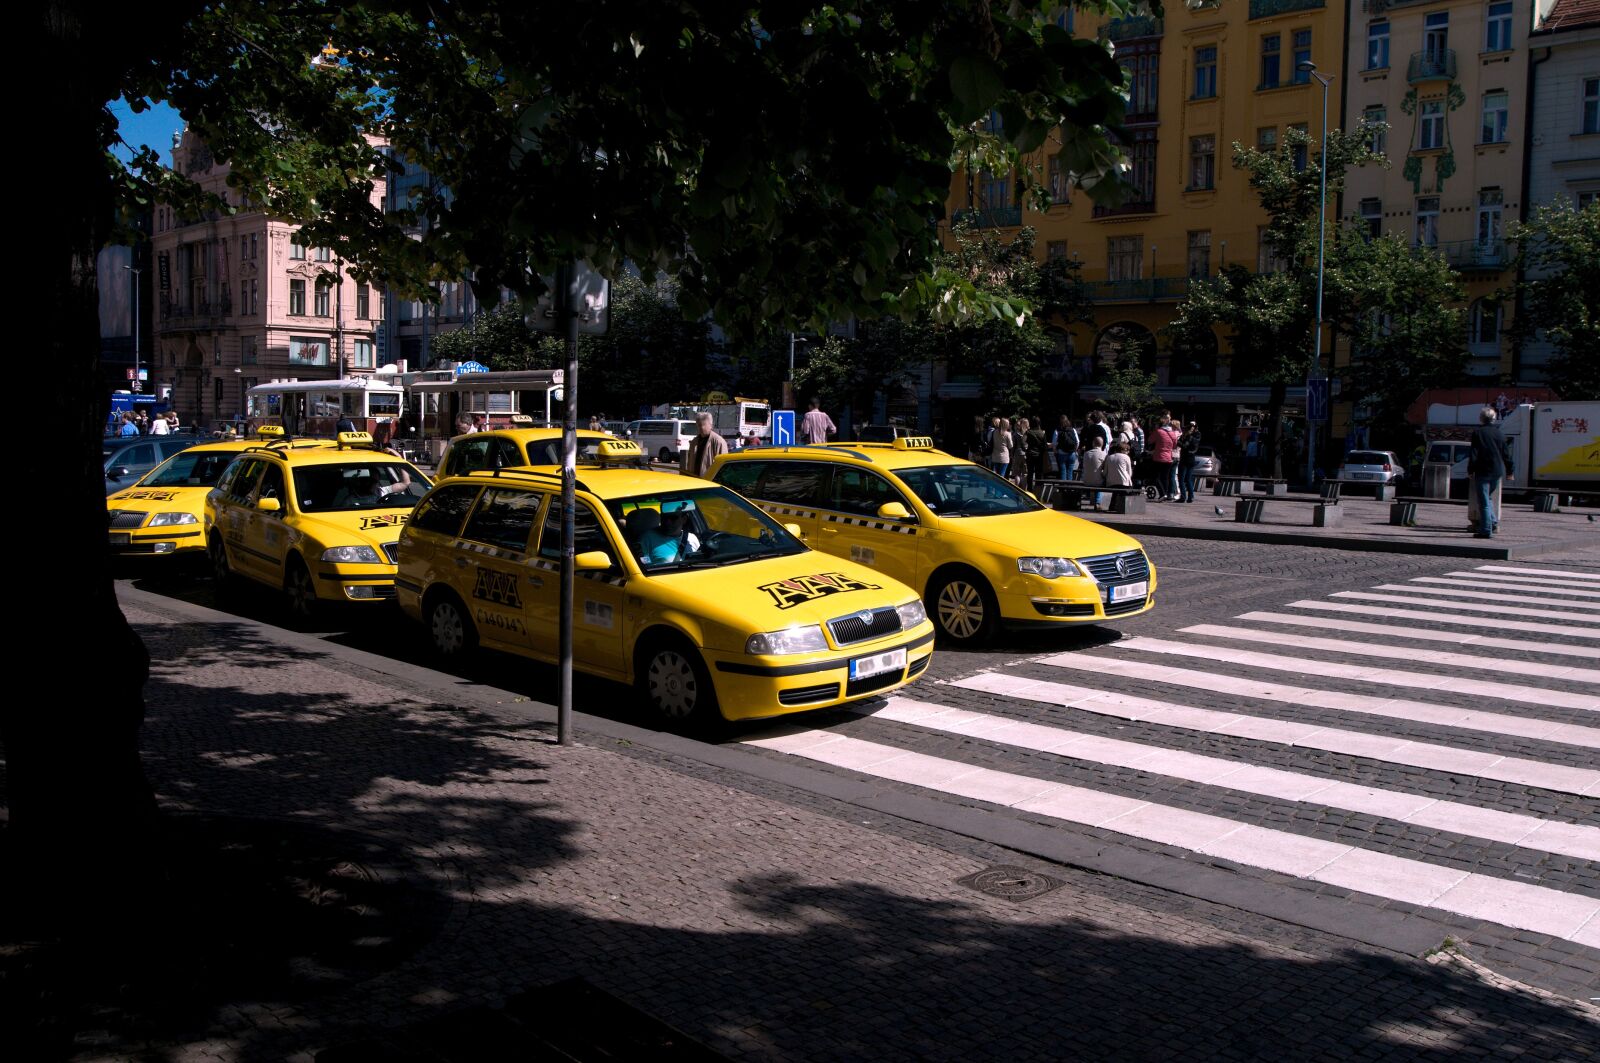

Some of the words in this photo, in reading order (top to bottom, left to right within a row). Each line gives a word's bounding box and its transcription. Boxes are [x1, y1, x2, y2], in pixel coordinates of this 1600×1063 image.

[908, 438, 929, 447] TAXI
[359, 513, 410, 530] AA
[472, 566, 522, 609] AAA
[757, 572, 883, 610] AAA
